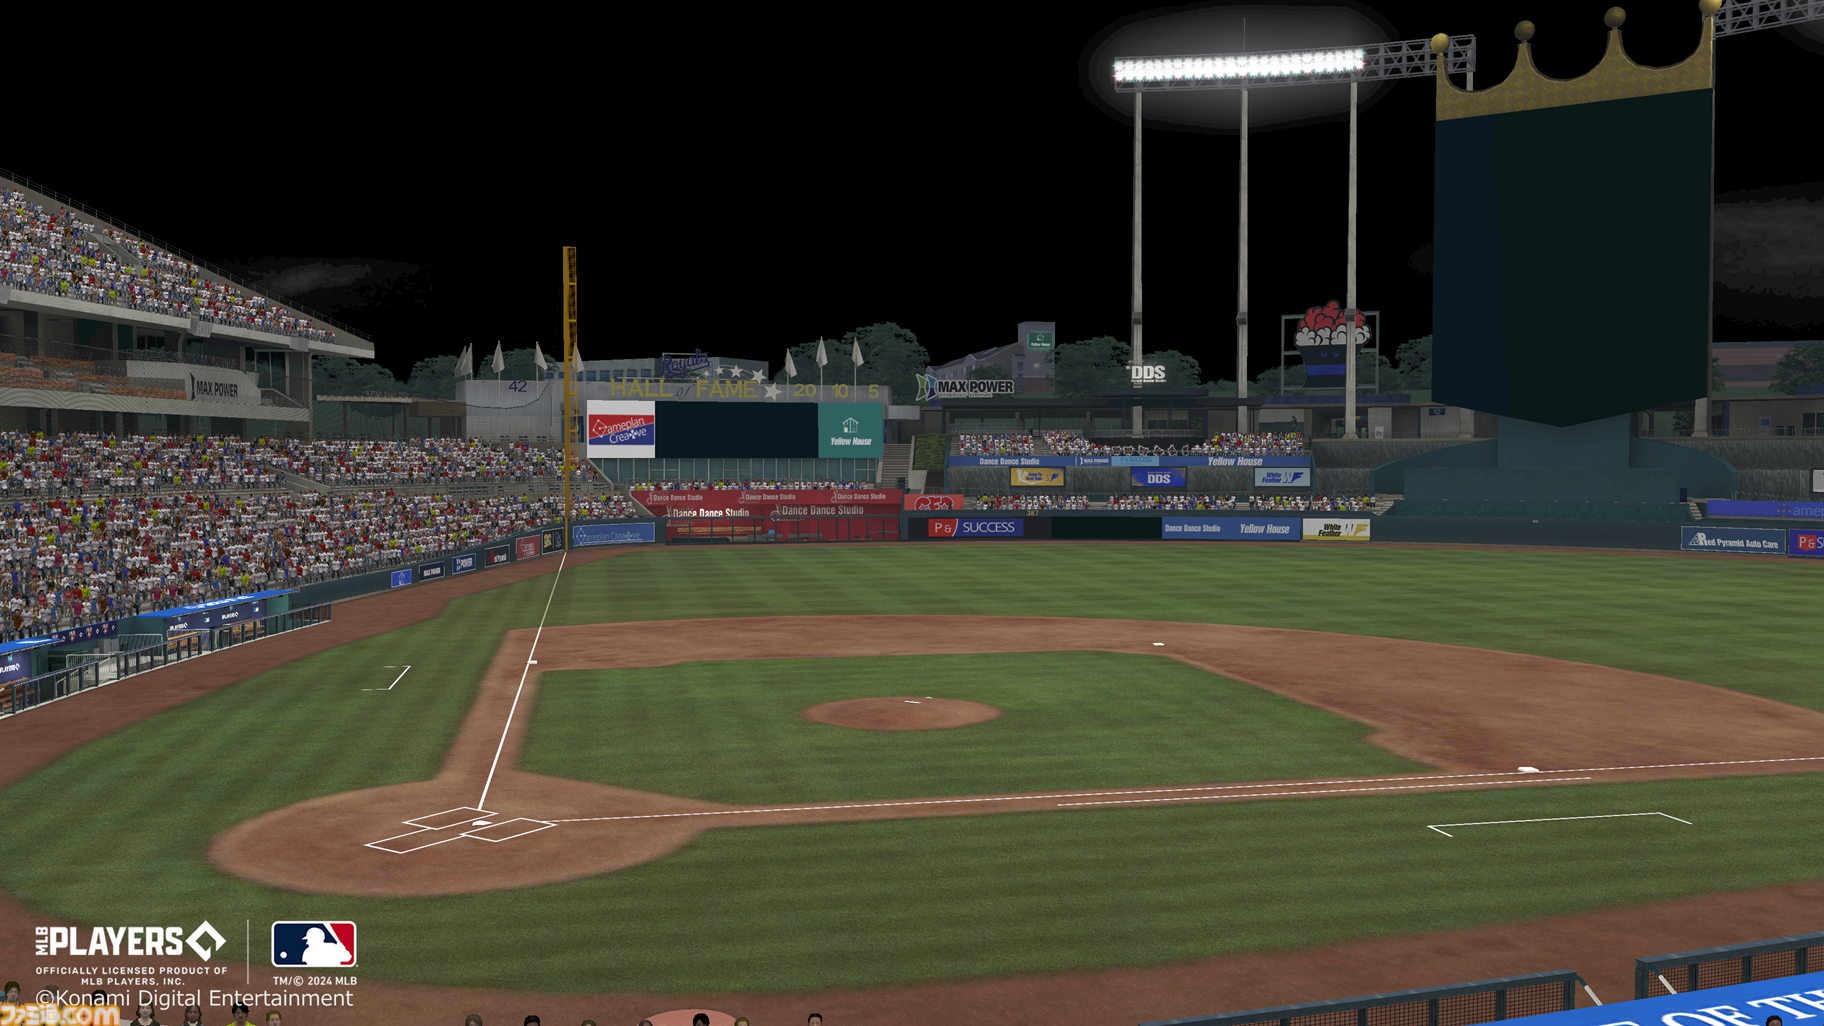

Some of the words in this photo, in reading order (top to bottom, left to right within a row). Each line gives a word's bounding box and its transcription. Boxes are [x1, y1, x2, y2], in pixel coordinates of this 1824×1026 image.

[658, 348, 709, 380] Royals
[1131, 365, 1166, 379] DDS
[196, 380, 213, 395] MAX
[214, 382, 239, 397] POWER
[508, 380, 527, 392] 42
[611, 378, 673, 397] HALL
[676, 383, 696, 400] of
[697, 379, 758, 398] FAME
[793, 383, 816, 397] 20
[831, 383, 849, 398] 10
[868, 384, 879, 399] 5
[938, 380, 967, 393] MAX
[968, 380, 1014, 394] POWER
[830, 437, 851, 446] Yellow
[852, 437, 872, 446] House
[979, 457, 999, 466] Dance
[1000, 457, 1019, 466] Dance
[1020, 457, 1040, 466] Studio
[1208, 456, 1236, 466] Yellow
[1237, 456, 1263, 466] House
[1147, 474, 1171, 484] DDS
[746, 493, 761, 501] Dance
[673, 508, 697, 518] Dance
[699, 508, 724, 518] Dance
[725, 507, 750, 518] Studio
[782, 505, 808, 515] Dance
[810, 505, 836, 515] Dance
[838, 504, 864, 515] Studio
[963, 521, 1015, 533] SUCCESS
[1165, 524, 1183, 533] Dance
[1184, 524, 1202, 533] Dance
[1202, 524, 1221, 533] Studio
[1240, 523, 1265, 534] Yellow
[1266, 523, 1290, 534] House
[1323, 523, 1342, 531] White
[1318, 529, 1342, 537] Feather
[1717, 539, 1745, 548] Pyramid
[1746, 539, 1762, 549] Auto
[1762, 540, 1779, 549] Care
[461, 557, 473, 569] POWER
